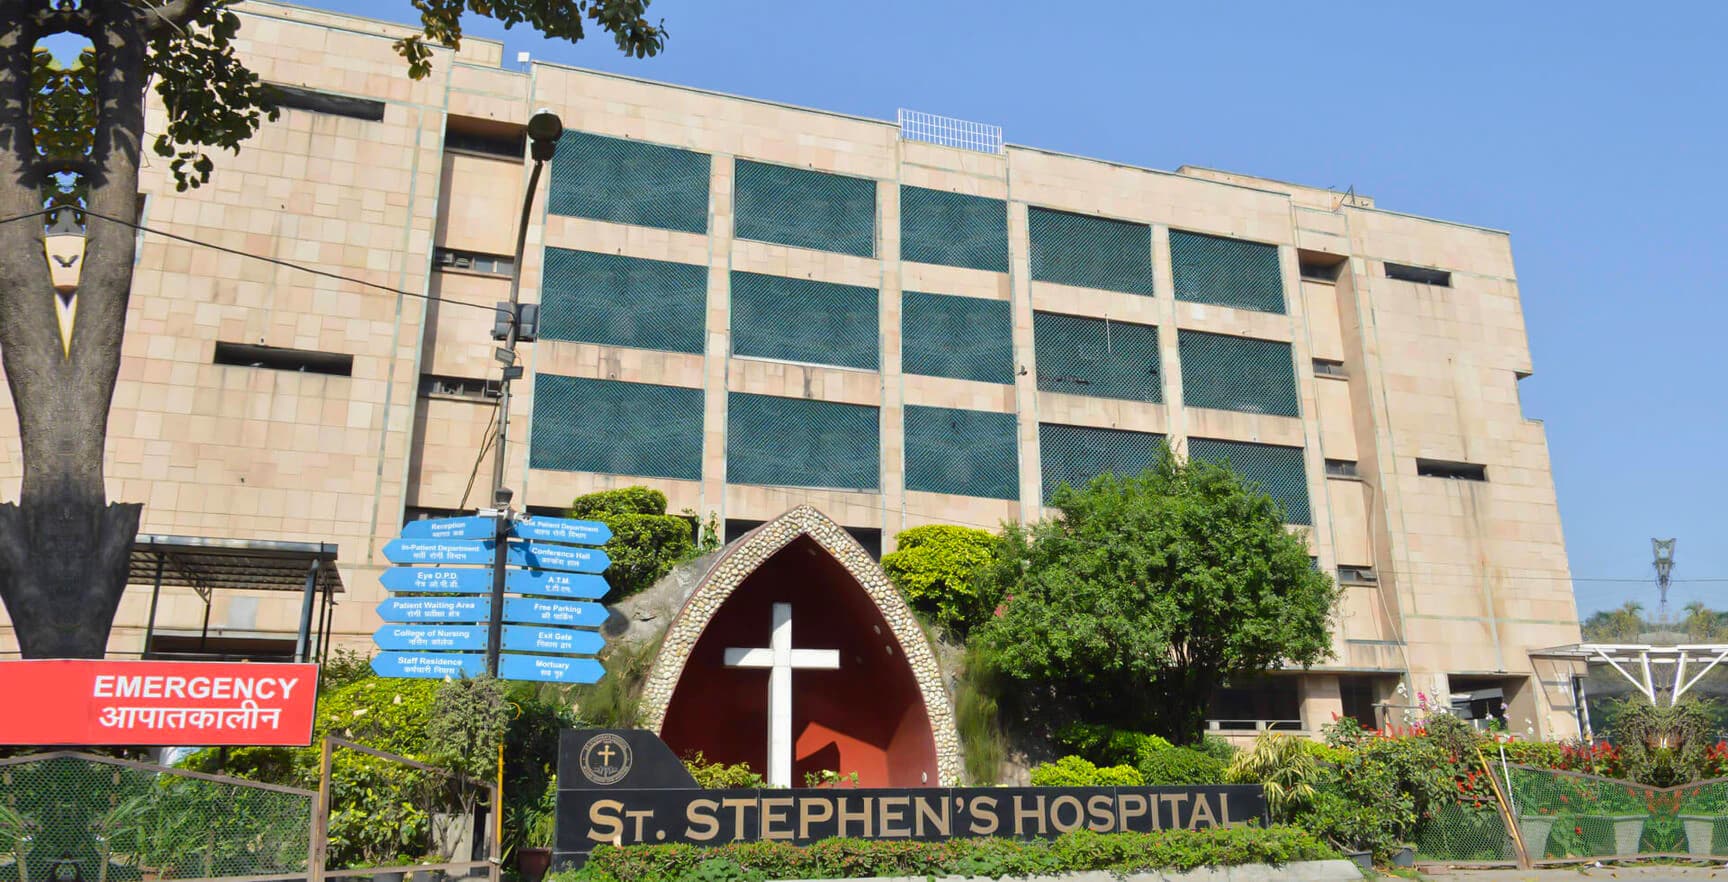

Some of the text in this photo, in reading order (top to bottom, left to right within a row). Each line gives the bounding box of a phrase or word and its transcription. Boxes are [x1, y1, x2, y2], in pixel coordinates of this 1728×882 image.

[431, 522, 466, 531] Reception
[537, 521, 561, 529] Patient
[561, 523, 599, 533] Department
[438, 544, 480, 552] Department
[531, 547, 591, 560] Conference Hall
[417, 571, 433, 580] Eye
[423, 602, 455, 610] Waiting
[534, 603, 582, 614] Free Parking
[393, 629, 470, 638] College of Nursing
[538, 632, 553, 640] Exit
[398, 656, 463, 666] Staff Residence
[535, 659, 570, 671] Mortuary
[93, 675, 298, 700] EMERGENCY
[99, 700, 281, 730] आपातकालीन
[684, 796, 1000, 841] STEPHEN'S
[1012, 792, 1249, 836] HOSPITAL
